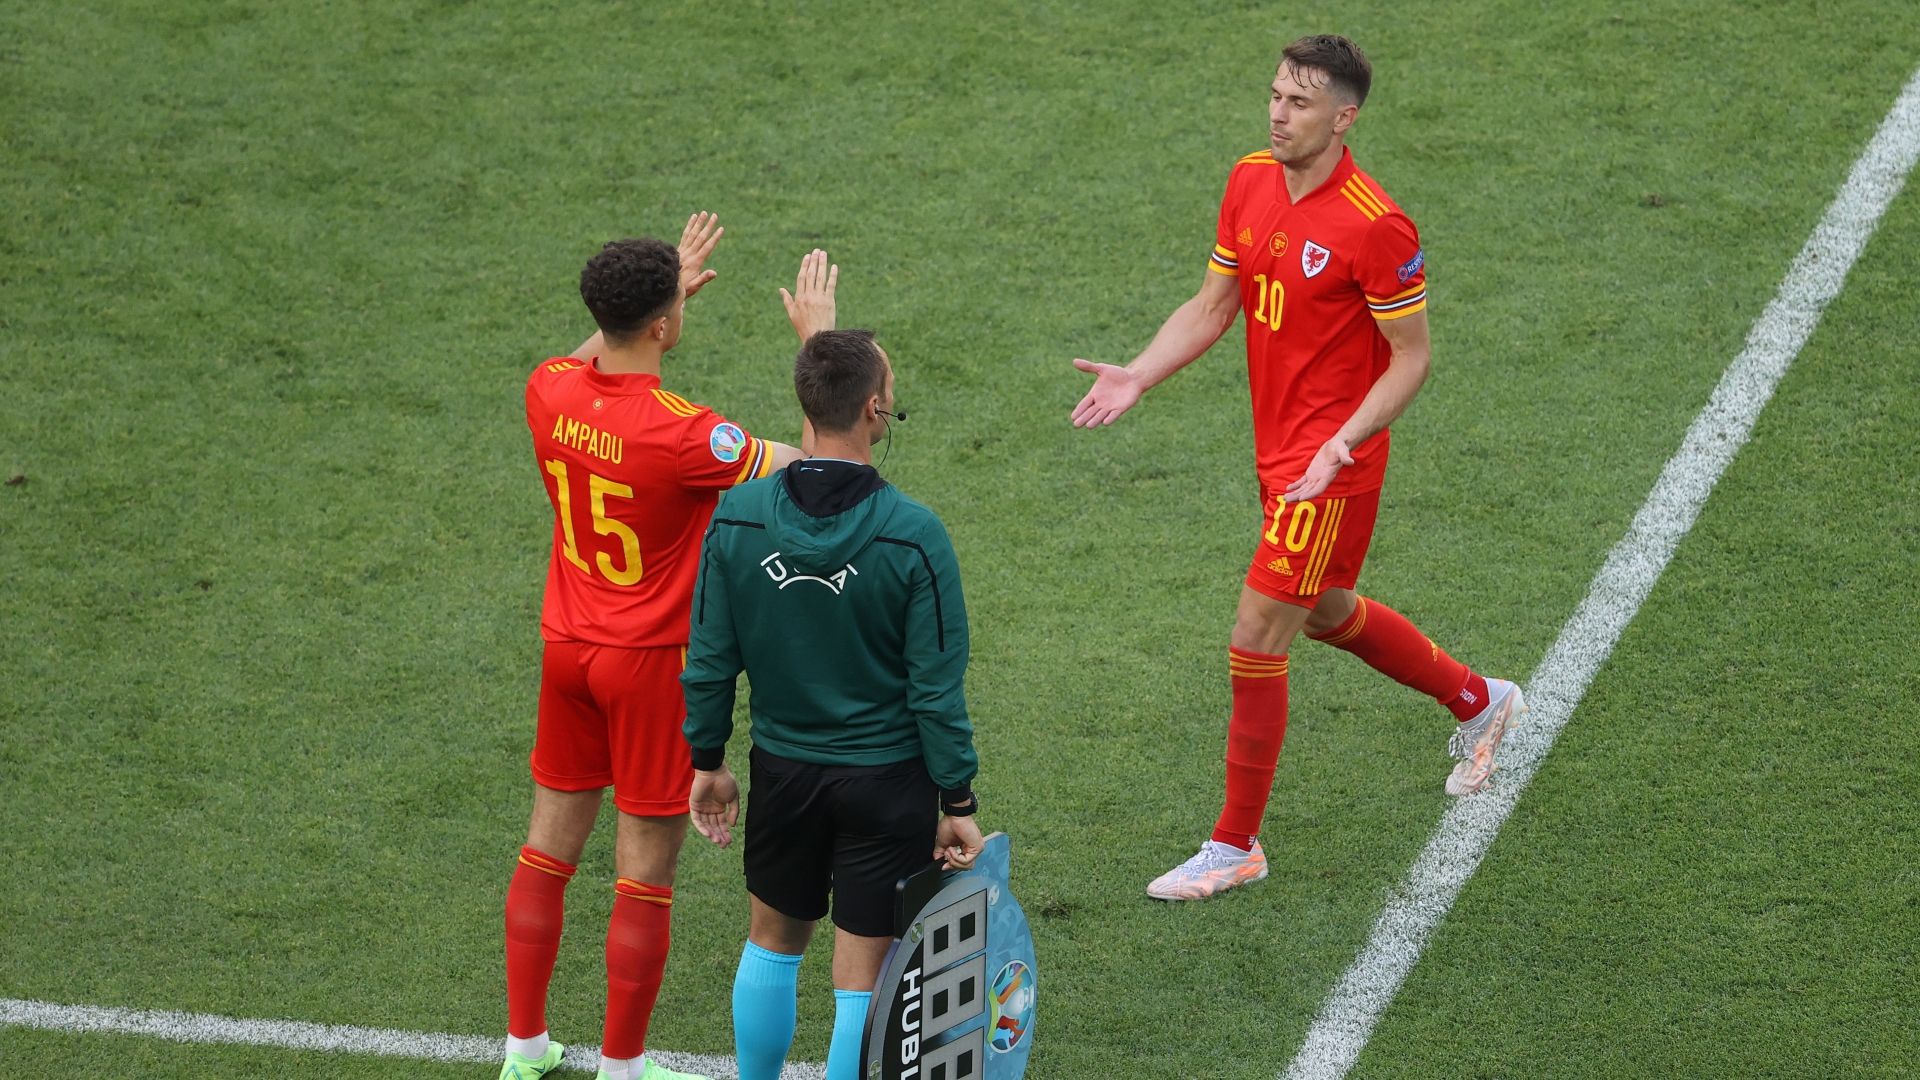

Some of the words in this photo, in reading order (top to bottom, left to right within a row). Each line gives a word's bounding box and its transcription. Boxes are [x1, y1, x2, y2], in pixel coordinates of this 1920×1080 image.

[1254, 274, 1285, 331] 10
[552, 414, 623, 464] AMPADU
[545, 459, 643, 586] 15
[1264, 495, 1316, 552] 10
[764, 556, 850, 592] UA
[901, 967, 921, 1080] HUBL
